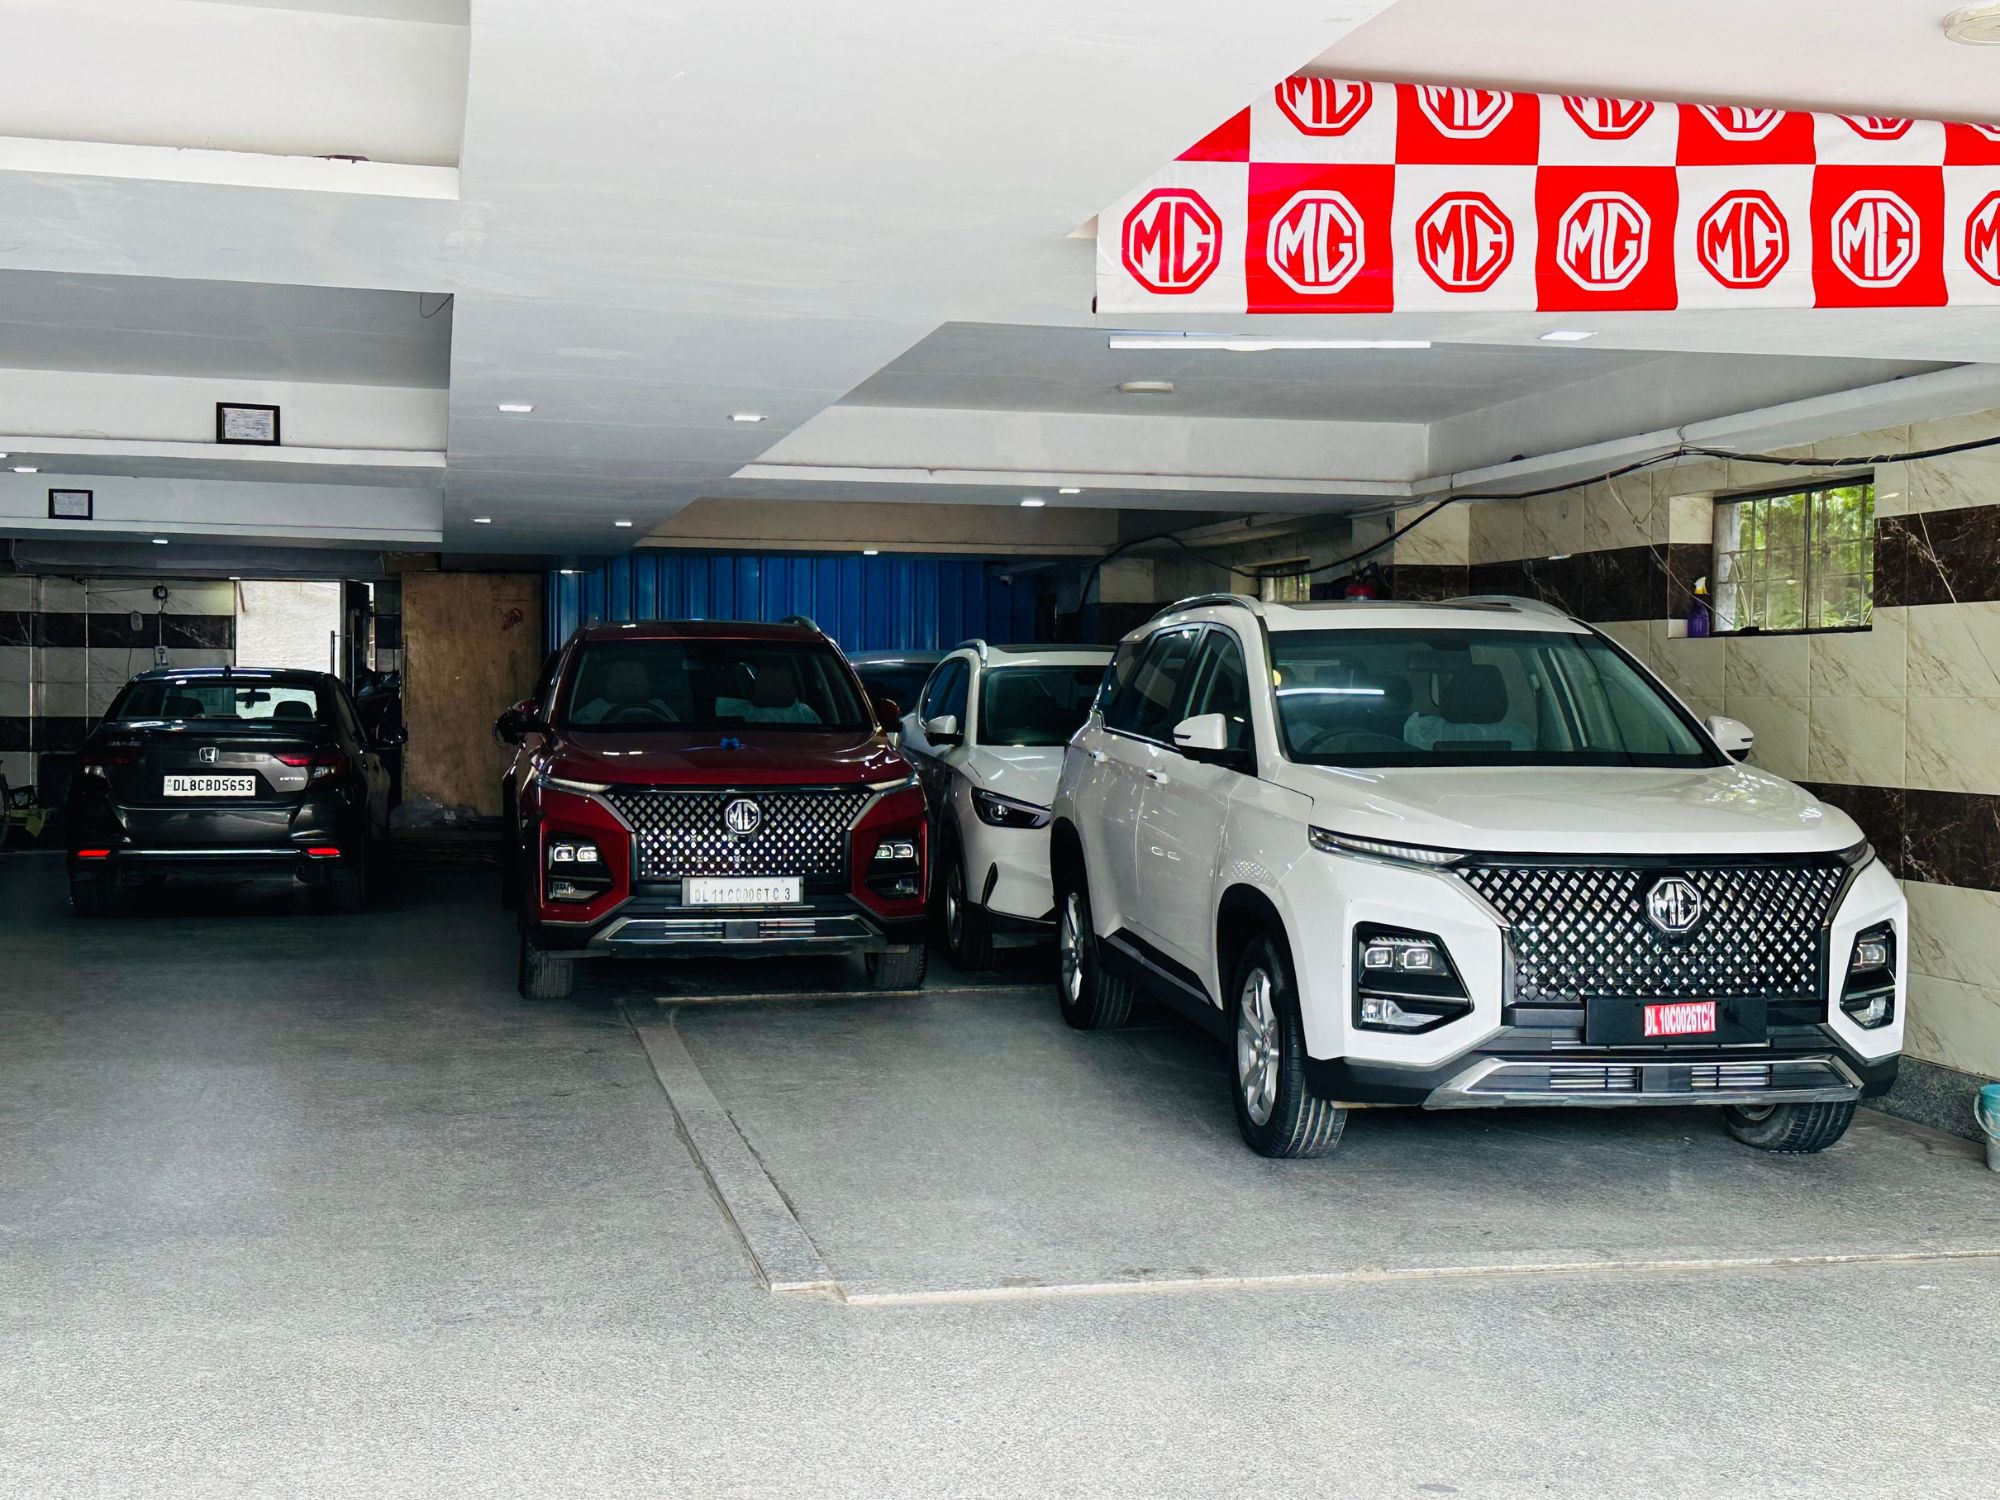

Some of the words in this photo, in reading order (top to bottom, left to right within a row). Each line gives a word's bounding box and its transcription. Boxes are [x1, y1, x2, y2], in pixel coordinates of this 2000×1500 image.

[1133, 200, 1211, 284] MG
[1278, 201, 1354, 283] MG
[1427, 203, 1503, 282] MG
[1566, 202, 1641, 281] MG
[1706, 202, 1779, 279] MG
[1840, 201, 1911, 278] MG
[1975, 202, 2000, 277] M
[173, 779, 253, 791] DL8CBD5653
[729, 802, 758, 831] MG
[1653, 882, 1697, 926] MG
